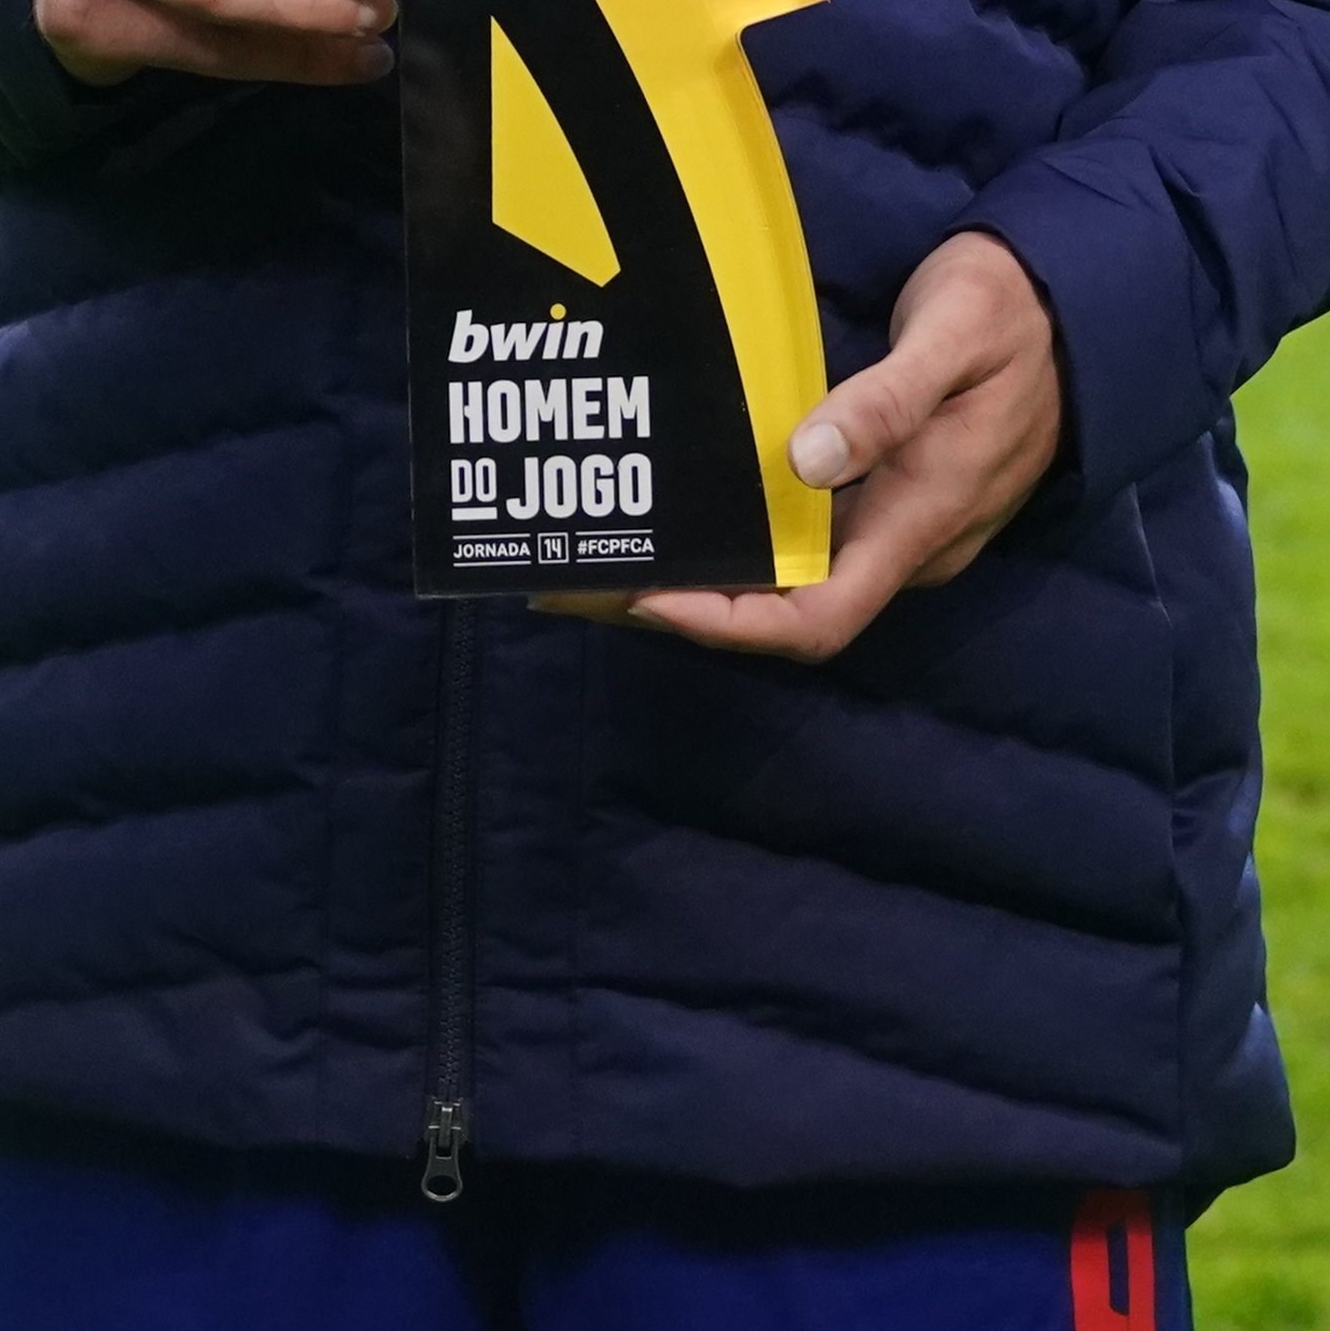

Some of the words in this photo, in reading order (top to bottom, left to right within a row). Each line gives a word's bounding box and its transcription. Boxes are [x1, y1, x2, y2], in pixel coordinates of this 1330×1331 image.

[447, 302, 604, 364] bwin
[448, 375, 652, 444] HOMEM
[450, 457, 498, 503] DO
[505, 452, 654, 520] JOGO
[453, 541, 532, 559] JORNADA
[542, 537, 563, 559] 14
[576, 537, 655, 556] #FCPFCA
